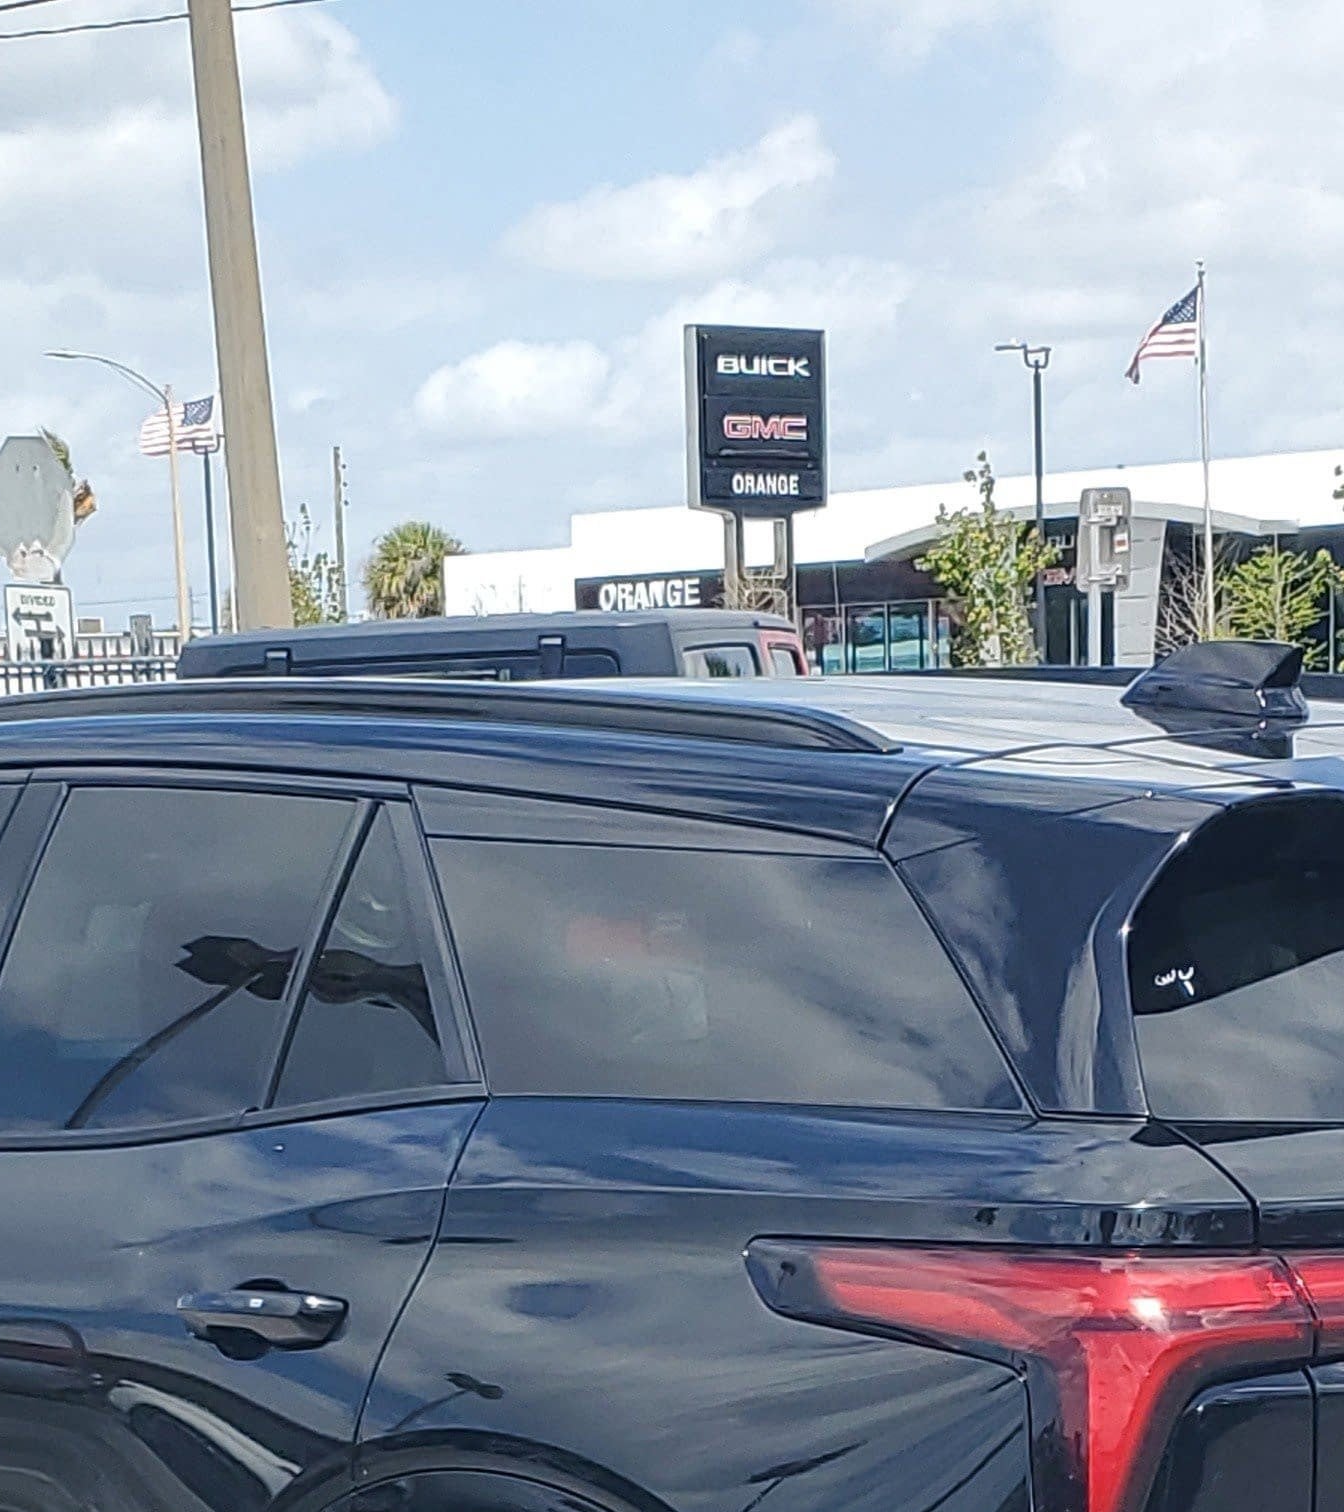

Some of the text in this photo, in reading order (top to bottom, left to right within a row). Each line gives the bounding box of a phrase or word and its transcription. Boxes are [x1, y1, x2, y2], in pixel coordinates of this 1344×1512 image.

[716, 354, 811, 377] BUICK
[723, 414, 807, 440] GMC
[731, 472, 800, 495] ORANGE
[598, 578, 701, 612] ORANGE
